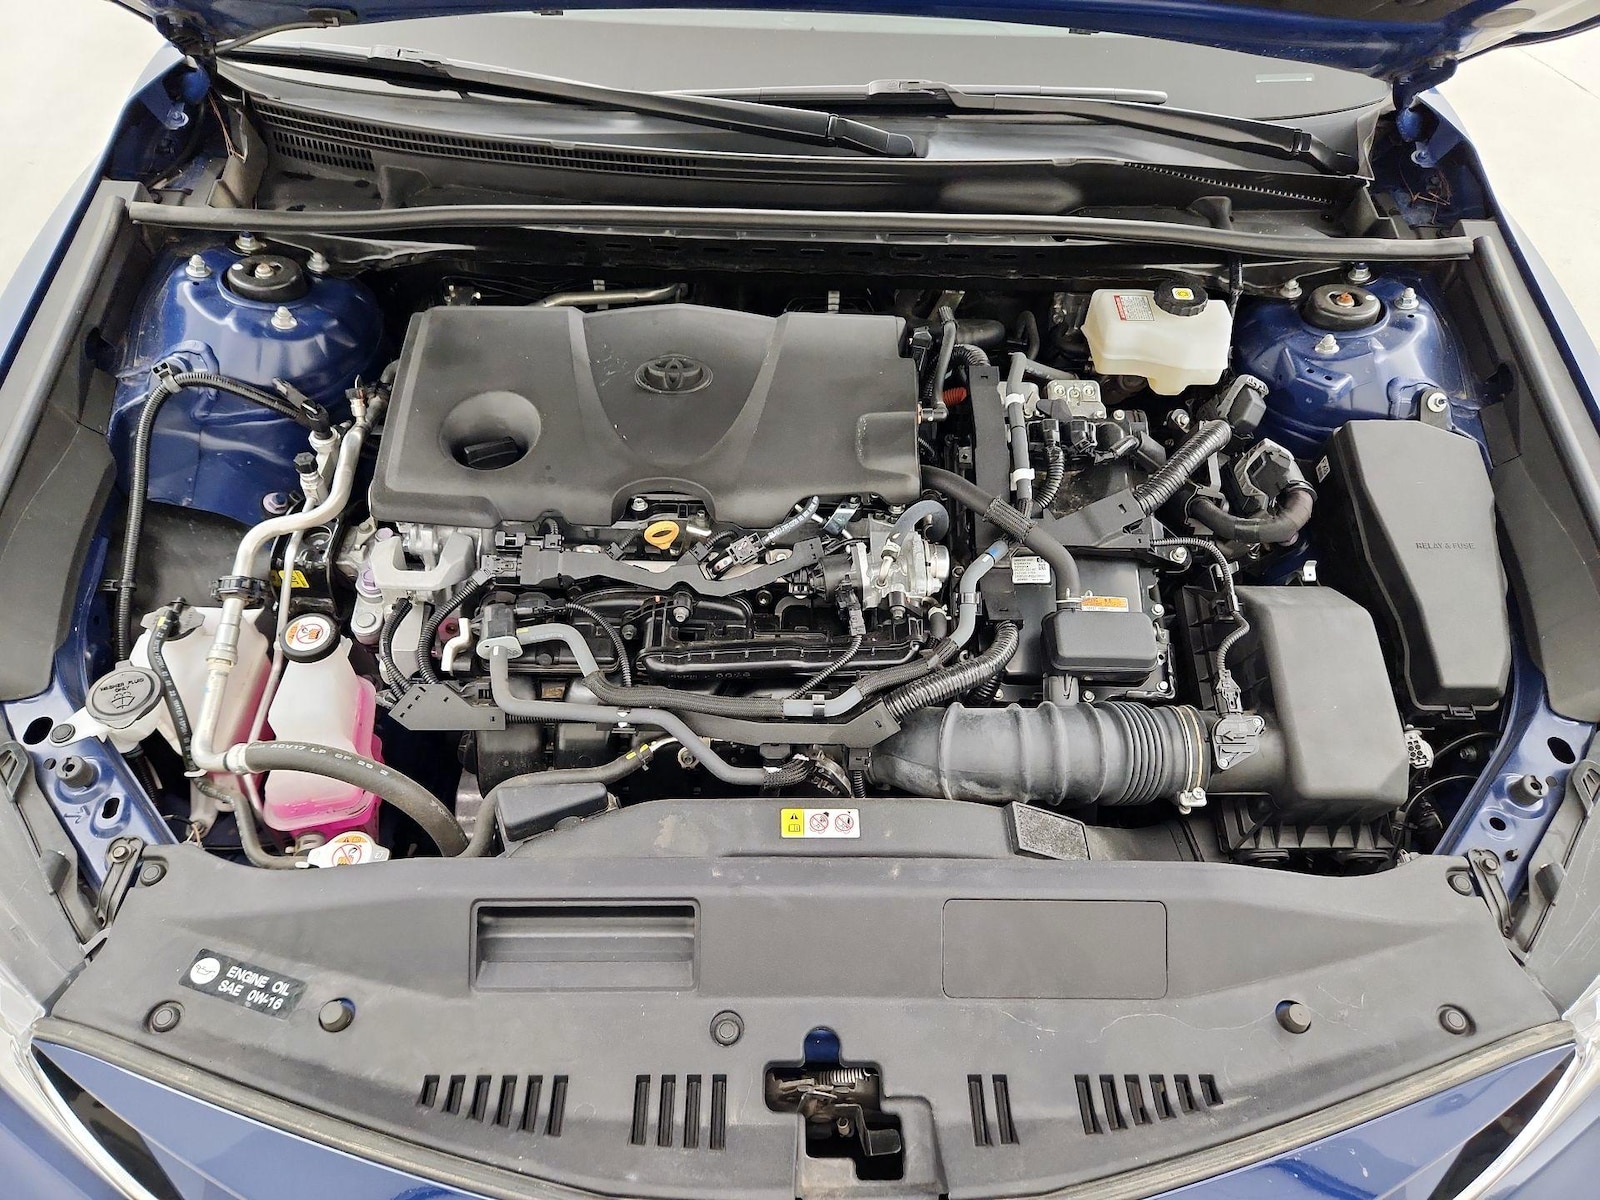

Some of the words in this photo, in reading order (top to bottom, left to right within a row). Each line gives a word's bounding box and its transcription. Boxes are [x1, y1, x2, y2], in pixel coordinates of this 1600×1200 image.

[217, 980, 245, 996] SAE
[246, 989, 284, 1010] 0W-16
[226, 966, 270, 988] ENGINE
[271, 980, 291, 996] OIL
